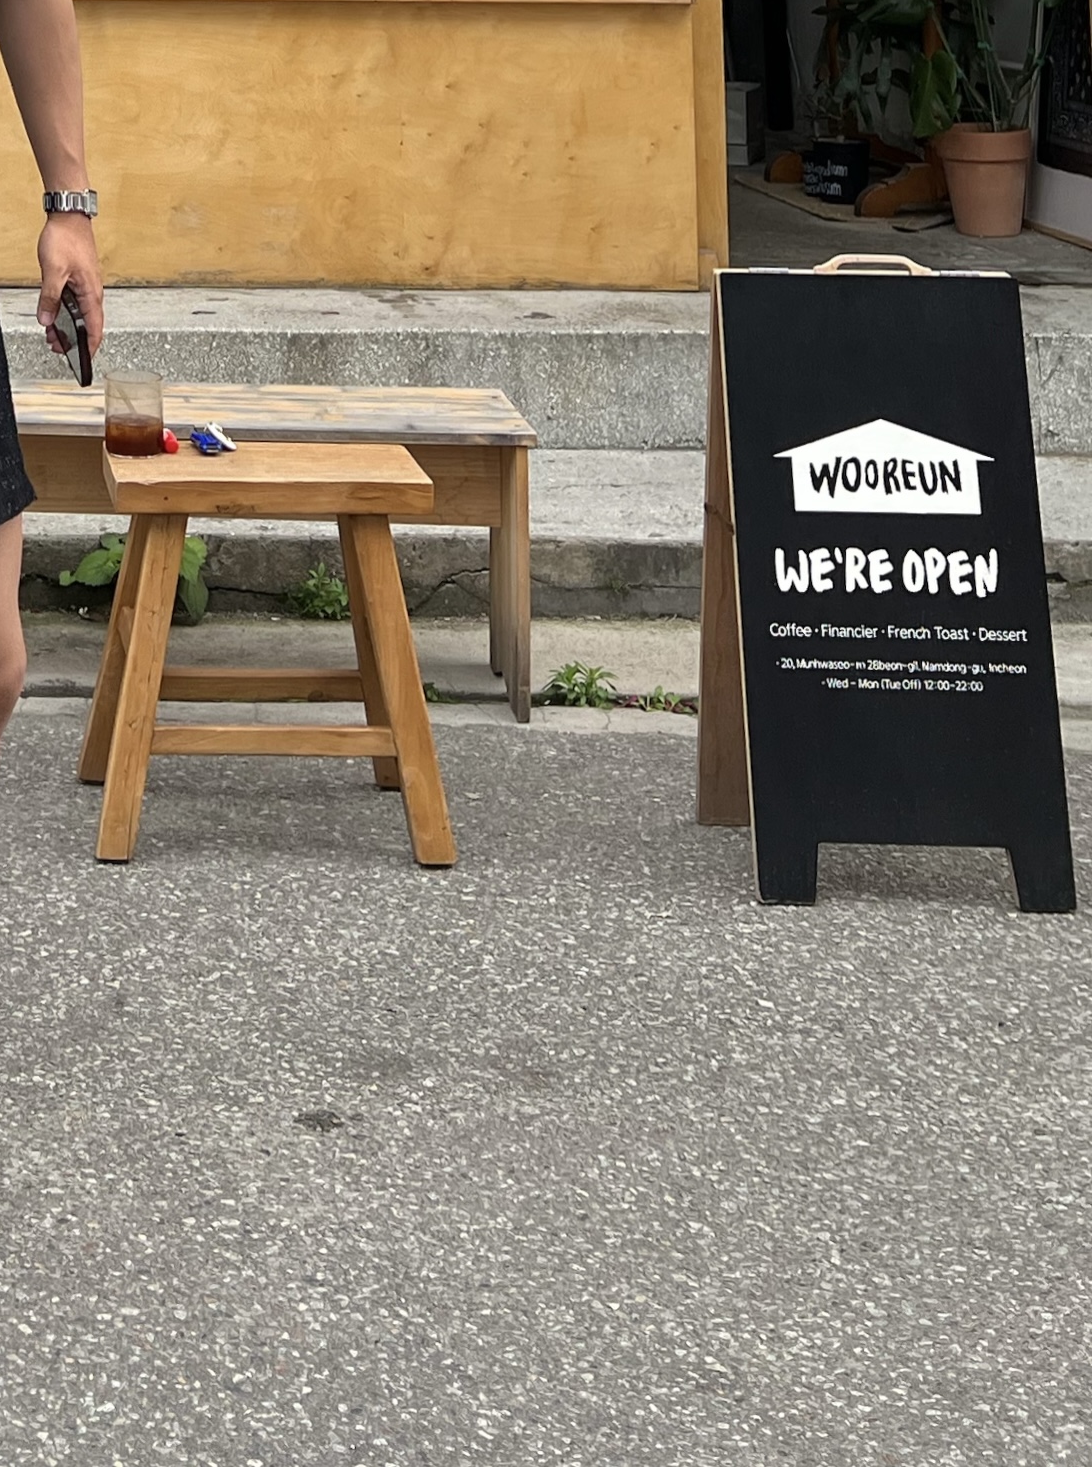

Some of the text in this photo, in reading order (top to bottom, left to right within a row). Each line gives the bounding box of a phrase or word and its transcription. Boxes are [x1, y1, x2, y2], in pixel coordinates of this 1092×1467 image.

[809, 456, 962, 499] WOOREUN
[774, 547, 999, 598] WE'RE OPEN
[769, 622, 1028, 642] Coffee Financier French Toast Dessert
[989, 662, 1027, 674] Incheon
[826, 677, 849, 689] Wed
[858, 678, 880, 690] Mon
